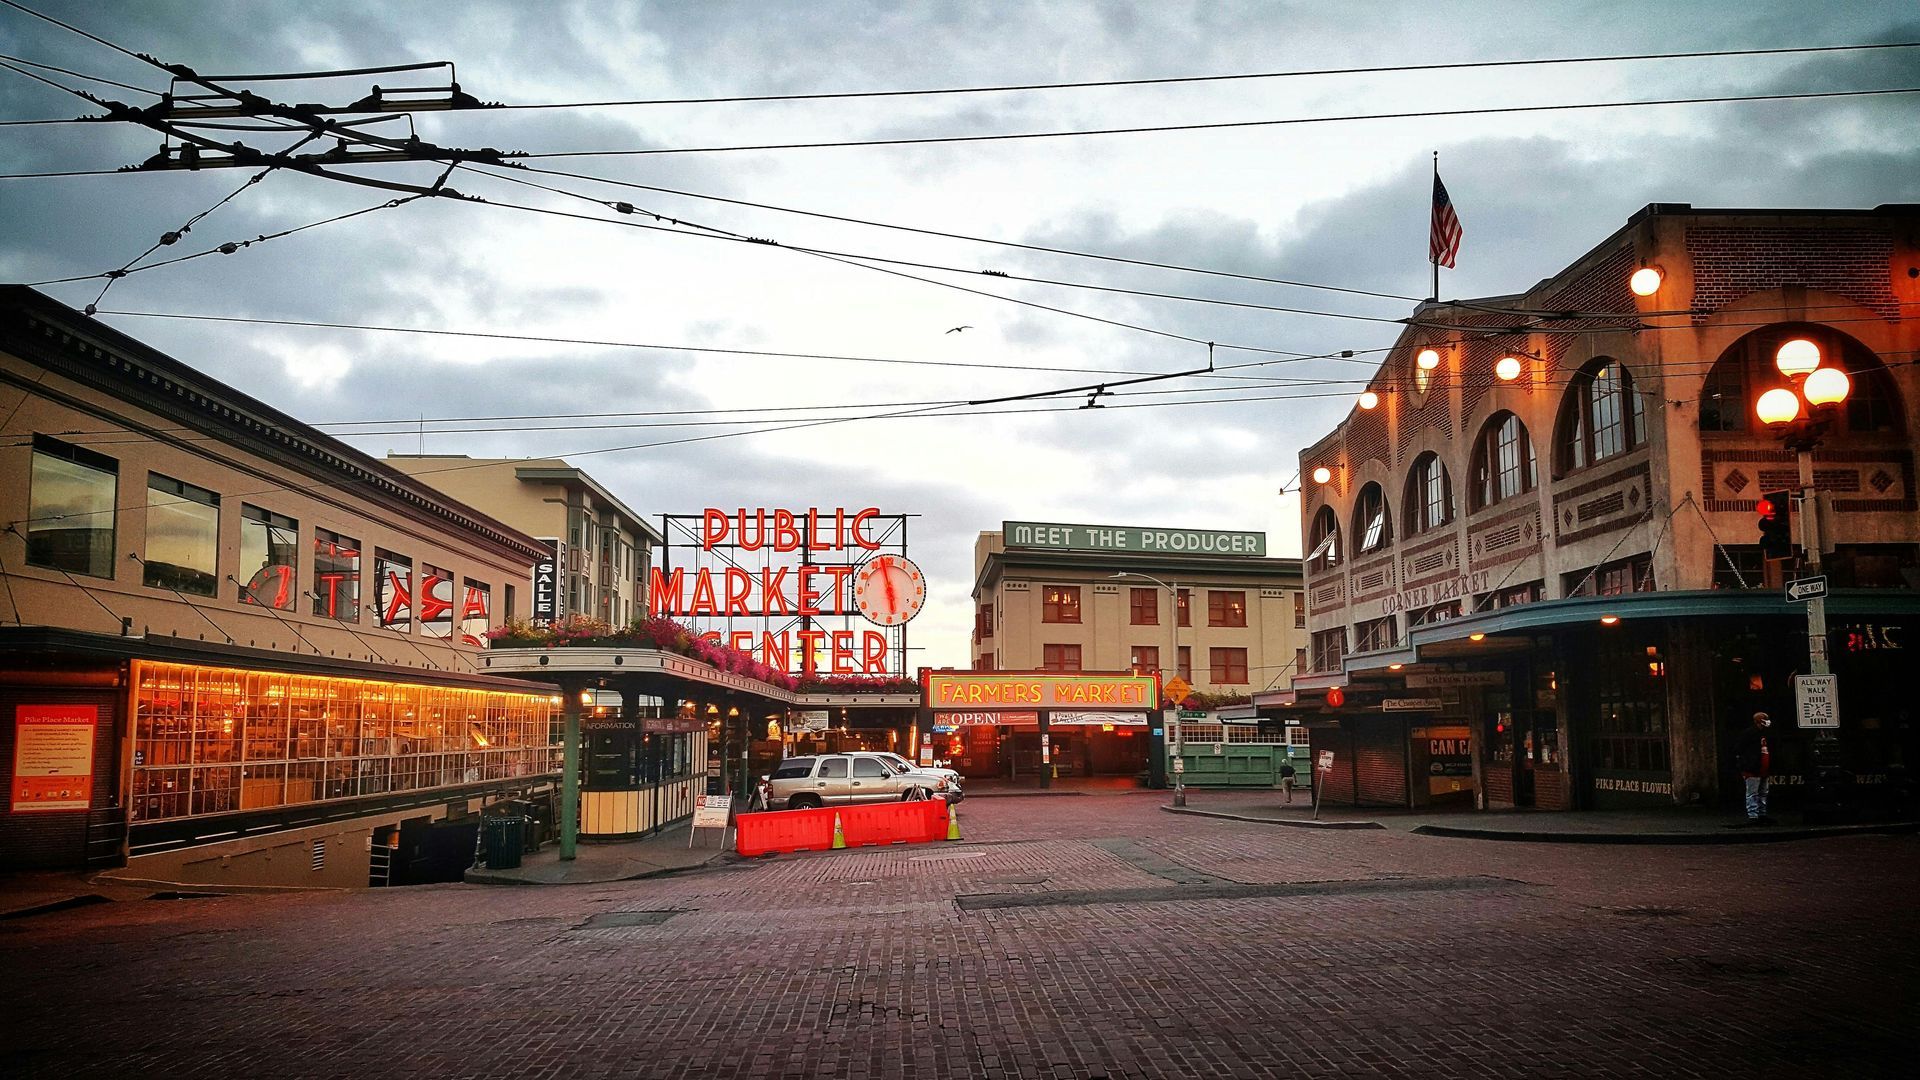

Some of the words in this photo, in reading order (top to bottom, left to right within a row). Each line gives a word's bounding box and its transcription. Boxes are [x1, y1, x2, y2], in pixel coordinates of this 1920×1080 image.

[703, 507, 881, 552] PUBLIC
[1015, 525, 1073, 545] MEET
[1086, 529, 1126, 548] THE
[1141, 531, 1257, 552] PRODUCER
[537, 563, 553, 612] SALLE
[649, 566, 854, 616] MARKET
[1382, 587, 1429, 615] CORNER
[1432, 571, 1490, 602] MARKET
[1798, 585, 1810, 594] ONE
[1810, 583, 1822, 592] WAY
[700, 630, 889, 675] ENTER
[940, 683, 1043, 703] FARMERS
[1055, 684, 1146, 703] MARKET
[951, 713, 1001, 725] OPEN!
[1430, 739, 1455, 755] CAN
[1595, 778, 1614, 790] PIKE
[1615, 780, 1640, 792] PLACE
